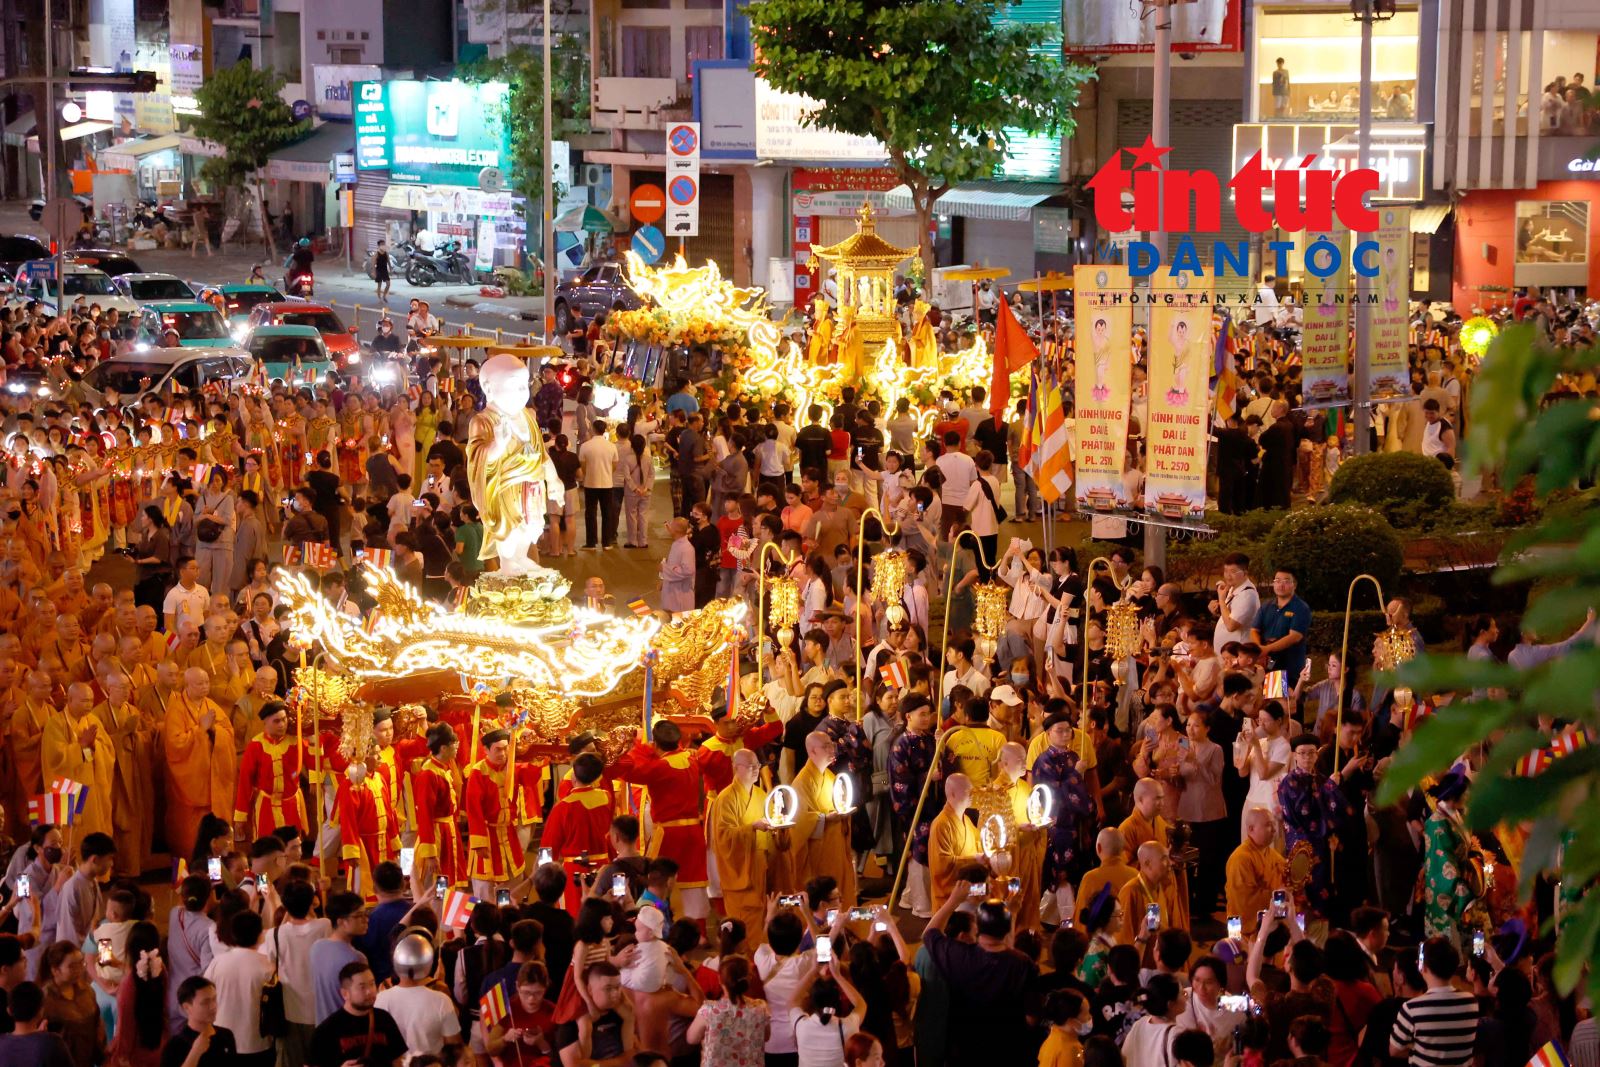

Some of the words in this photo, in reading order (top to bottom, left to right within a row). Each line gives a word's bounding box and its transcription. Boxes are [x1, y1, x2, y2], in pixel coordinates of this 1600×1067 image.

[1085, 455, 1097, 465] PL.
[1156, 460, 1168, 470] PL.
[1170, 461, 1190, 472] 2570
